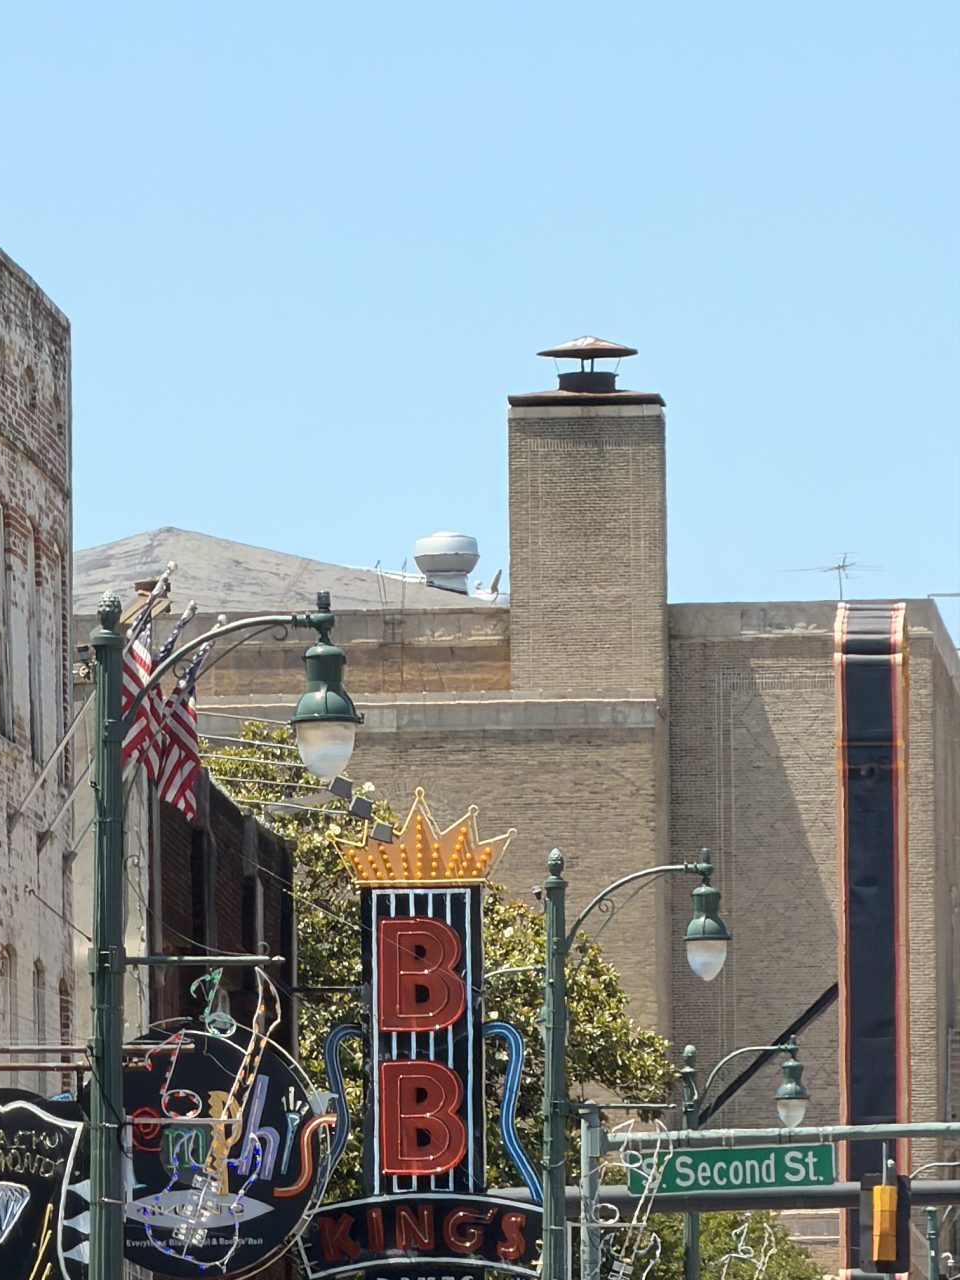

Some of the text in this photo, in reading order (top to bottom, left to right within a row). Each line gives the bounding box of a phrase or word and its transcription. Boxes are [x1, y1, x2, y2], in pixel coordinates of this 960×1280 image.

[378, 915, 467, 1033] B
[130, 1074, 338, 1198] emphis
[378, 1059, 467, 1176] B
[675, 1152, 776, 1188] Second
[784, 1150, 824, 1183] St.
[318, 1204, 527, 1263] KING'S
